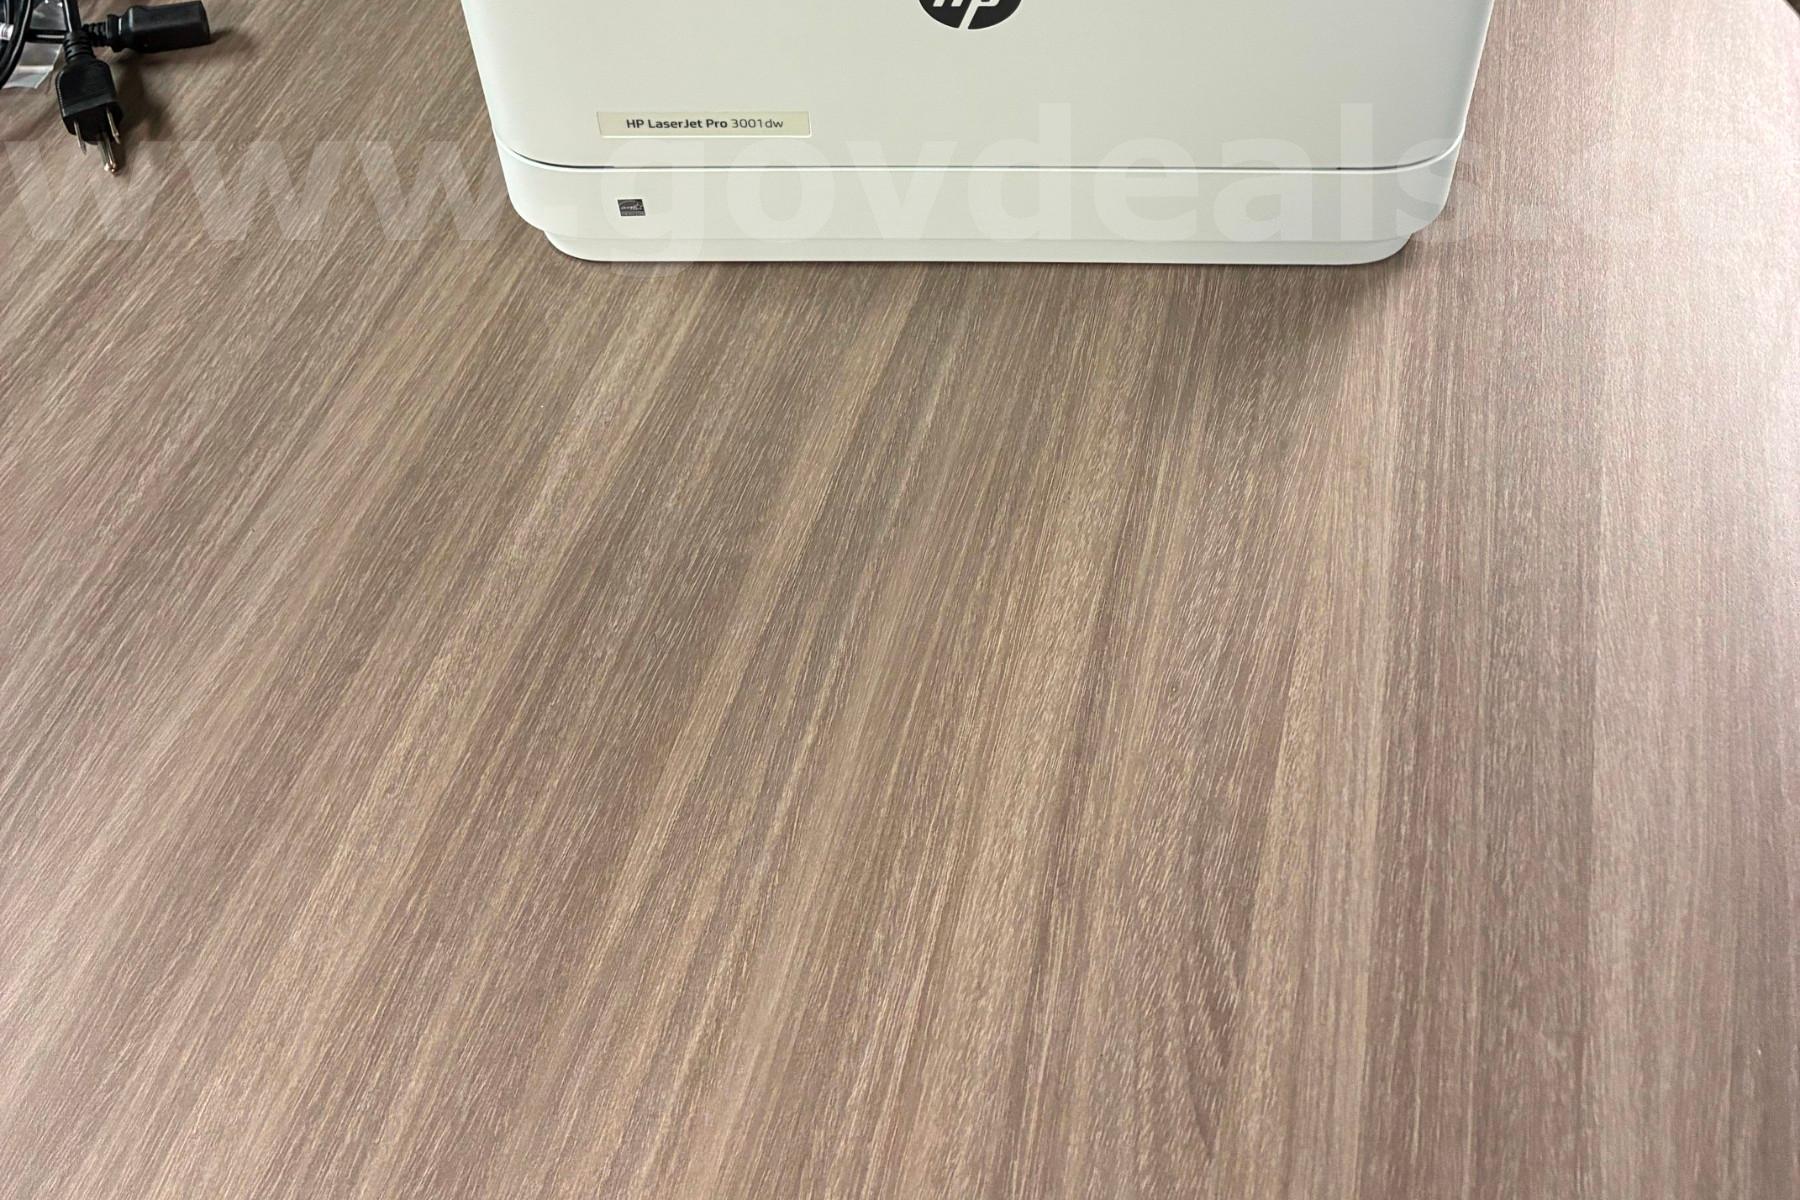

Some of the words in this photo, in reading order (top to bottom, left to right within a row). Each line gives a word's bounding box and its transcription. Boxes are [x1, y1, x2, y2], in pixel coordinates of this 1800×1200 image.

[626, 119, 645, 129] HP
[648, 118, 703, 129] LaserJet
[706, 119, 728, 129] Pro
[731, 118, 784, 129] 3001dw
